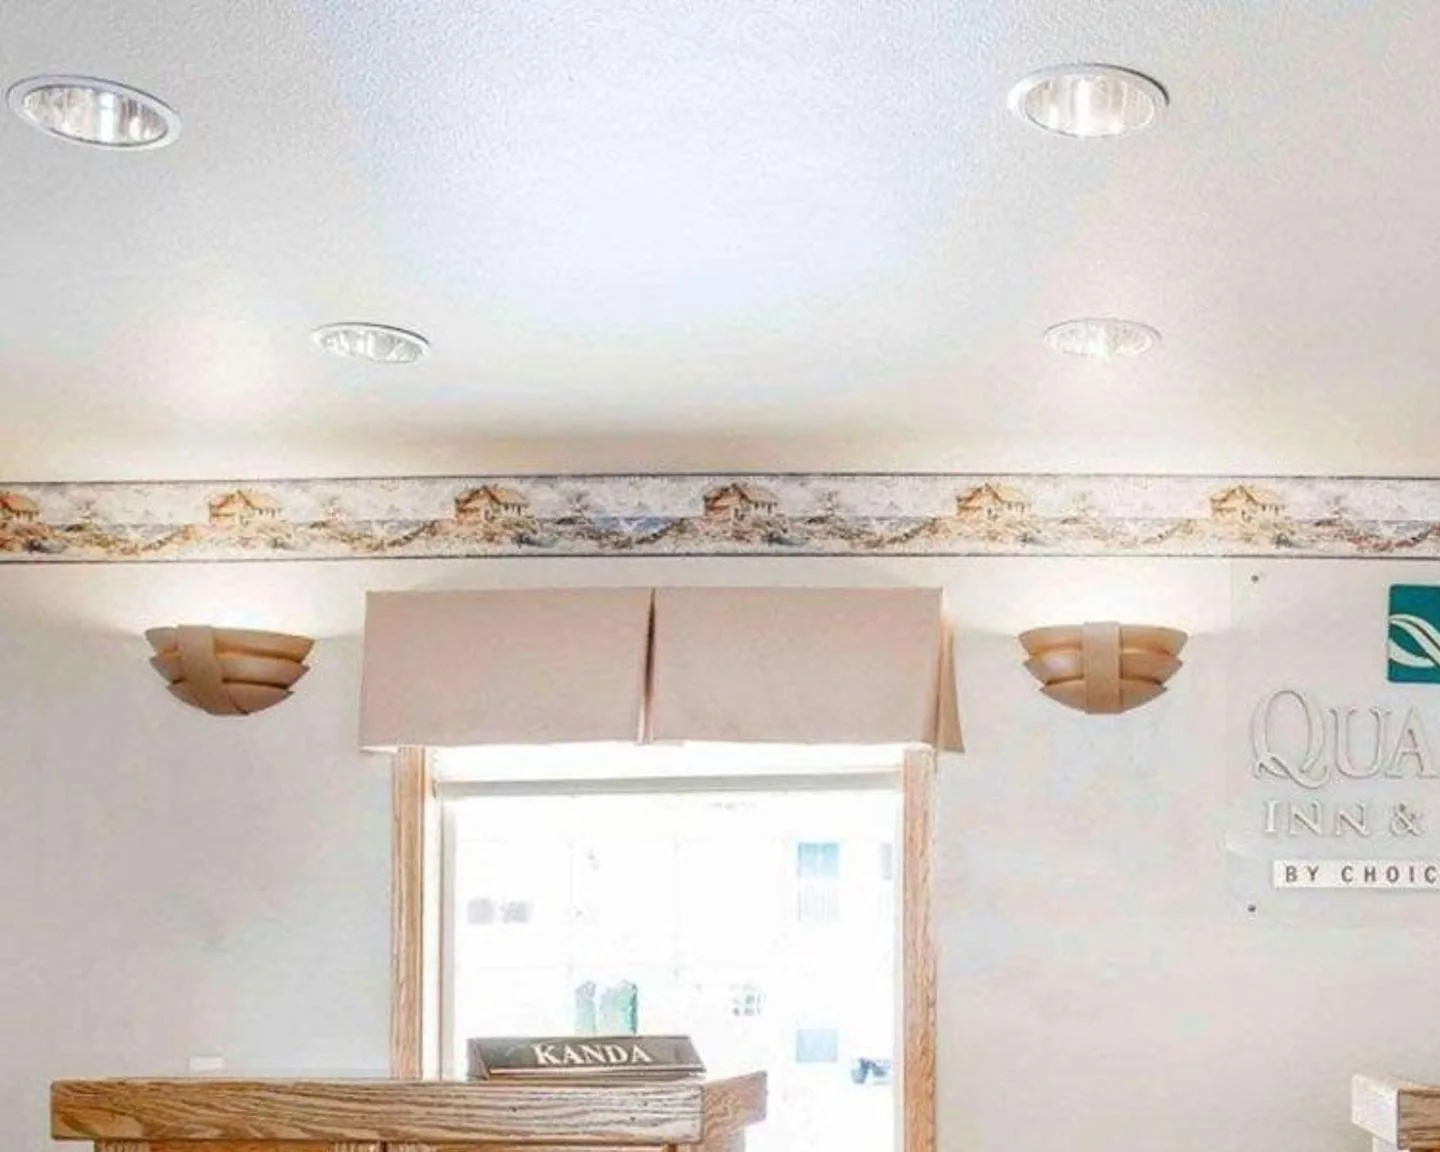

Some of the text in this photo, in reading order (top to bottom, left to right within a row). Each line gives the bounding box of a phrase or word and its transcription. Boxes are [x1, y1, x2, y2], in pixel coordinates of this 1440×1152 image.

[1264, 800, 1368, 838] INN
[1390, 802, 1424, 838] &
[1285, 866, 1320, 884] BY
[532, 1043, 653, 1066] KANDA
